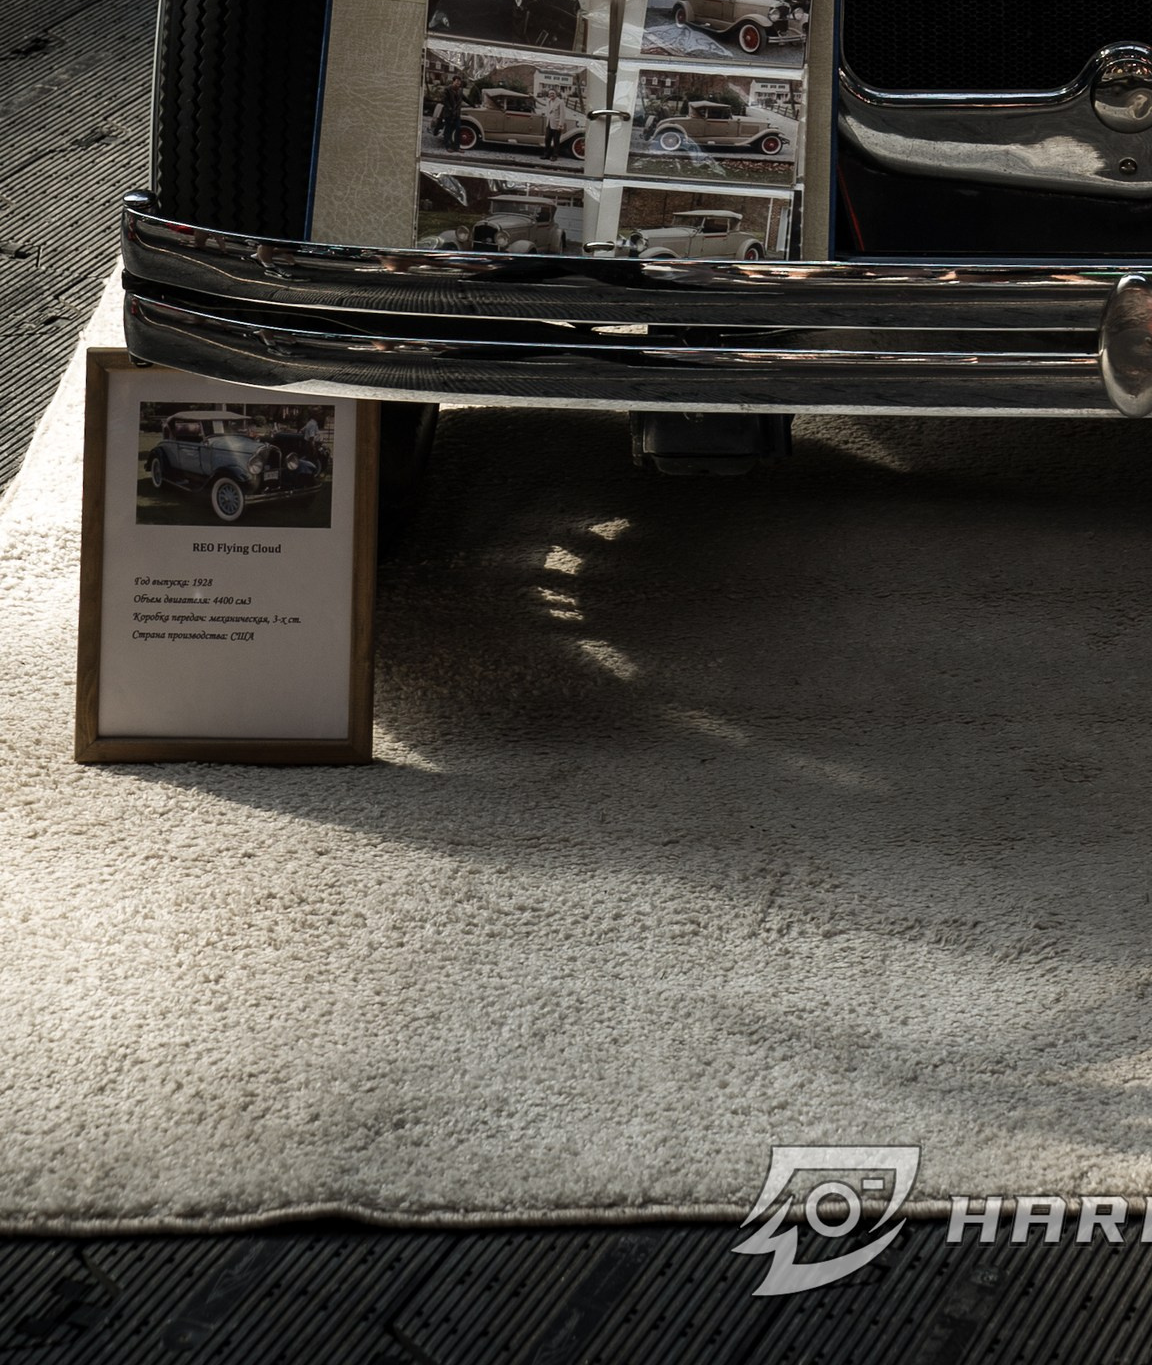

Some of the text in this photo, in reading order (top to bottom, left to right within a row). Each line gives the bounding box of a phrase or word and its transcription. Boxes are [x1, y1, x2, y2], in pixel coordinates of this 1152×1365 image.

[192, 542, 282, 555] REO Flying Cloud
[134, 576, 214, 589] Год выпуска: 1928
[133, 593, 252, 606] Объем двигателя: 4400 см3
[133, 611, 169, 624] Коробка
[171, 612, 207, 625] передач:
[208, 615, 270, 625] механическая,
[132, 629, 255, 642] Страна производства: США
